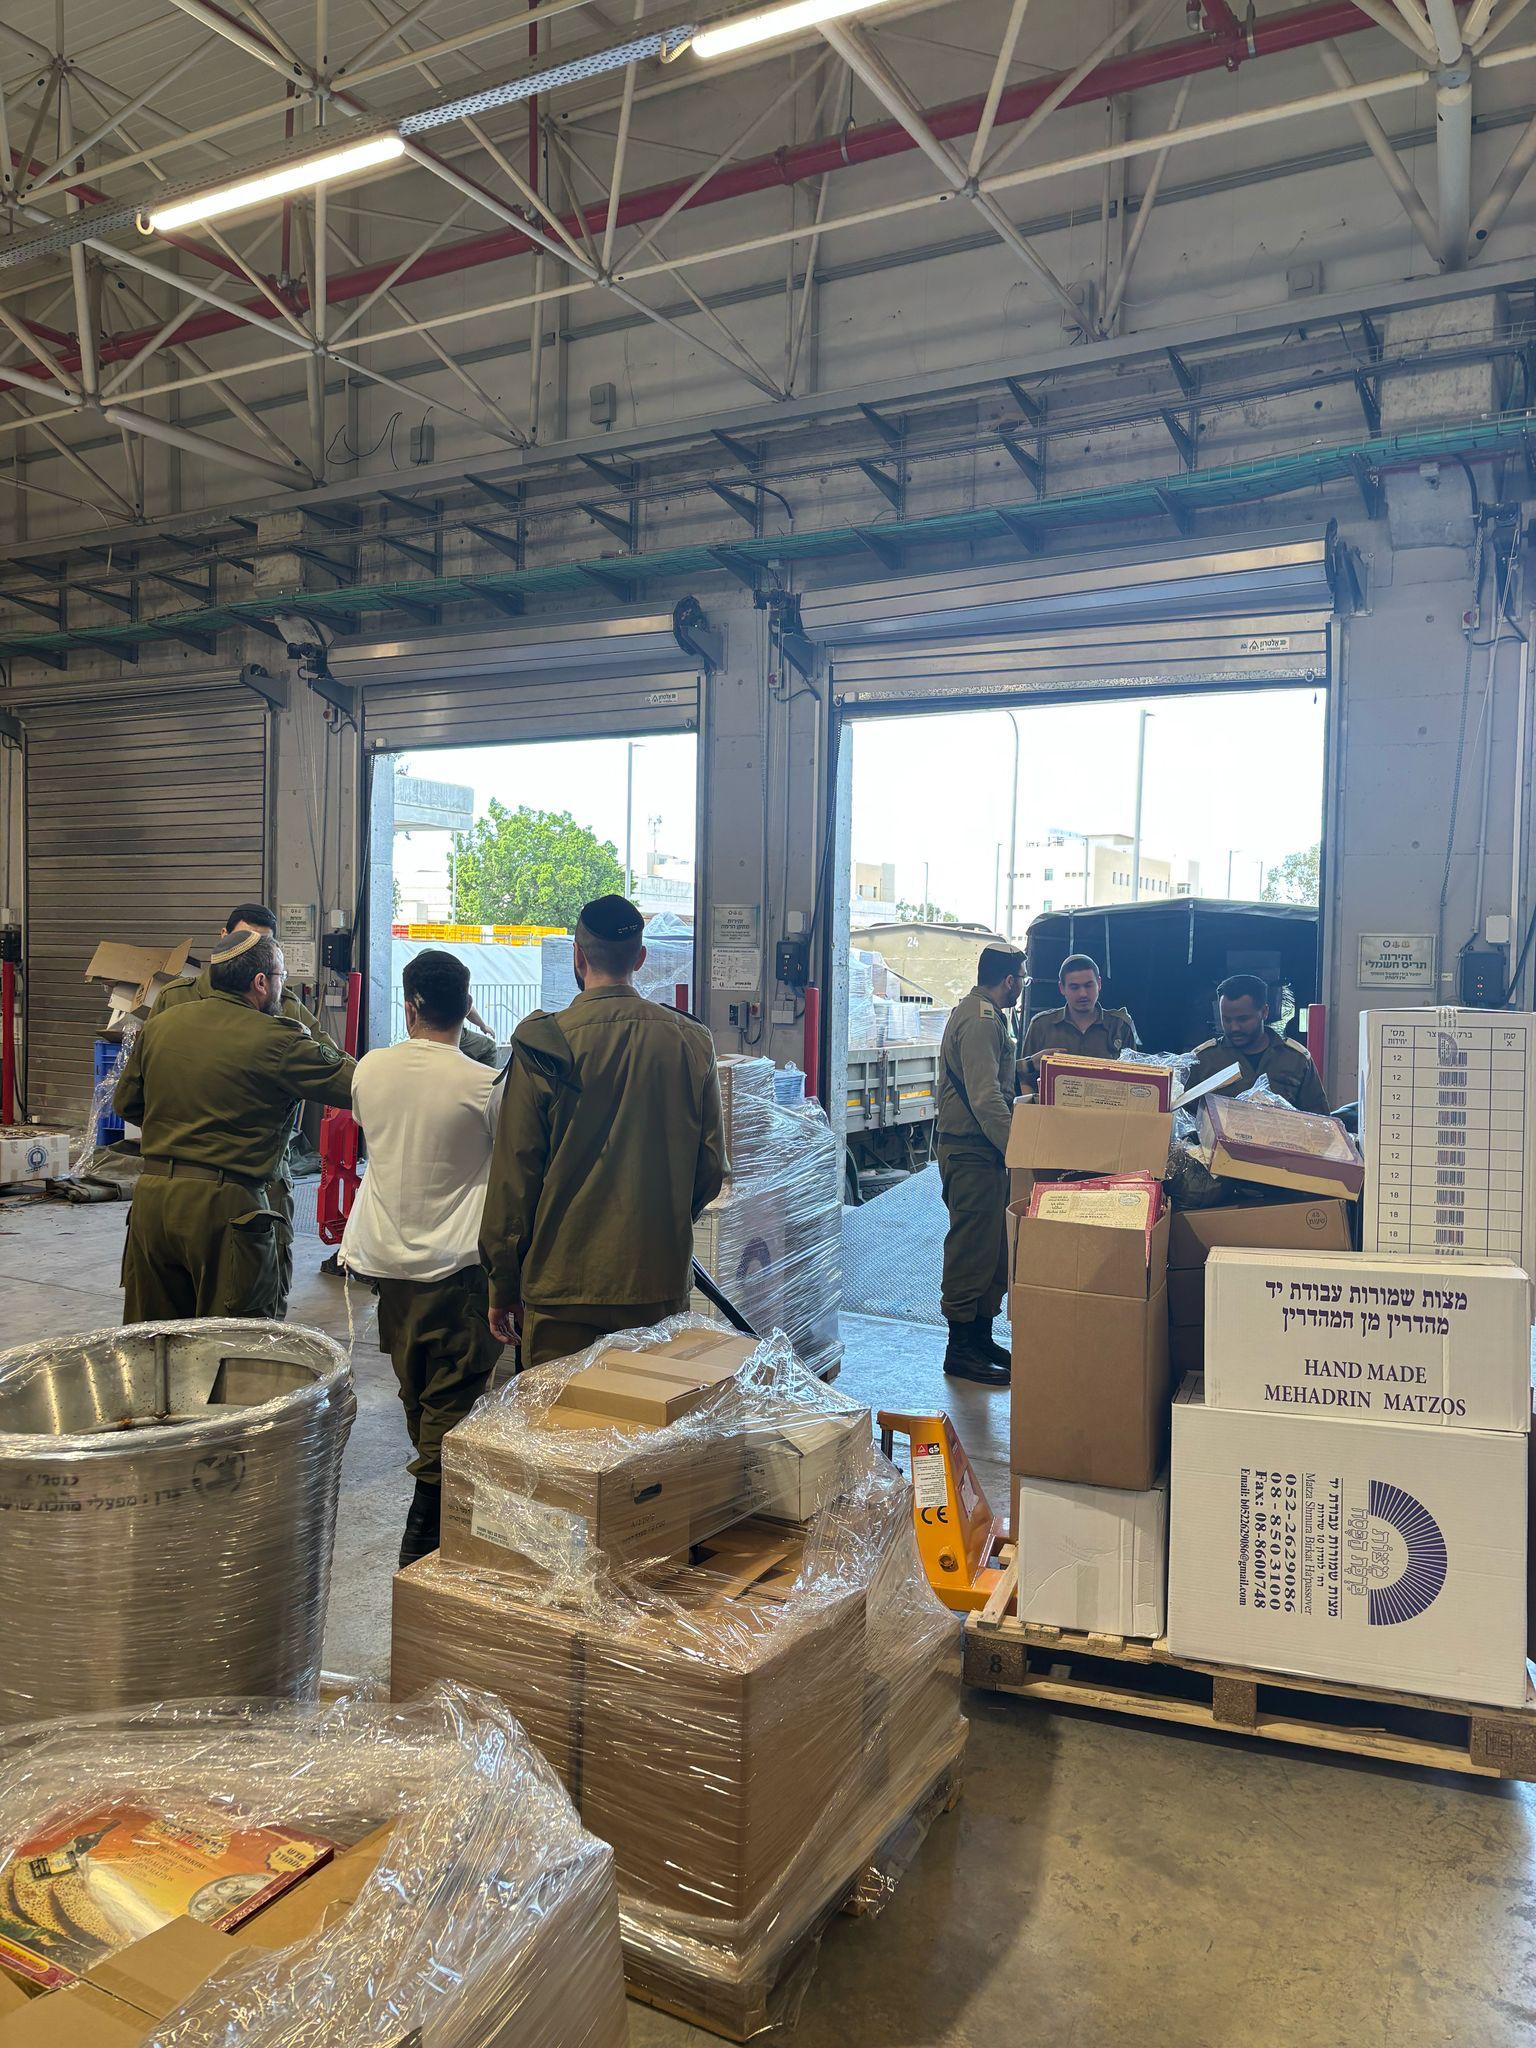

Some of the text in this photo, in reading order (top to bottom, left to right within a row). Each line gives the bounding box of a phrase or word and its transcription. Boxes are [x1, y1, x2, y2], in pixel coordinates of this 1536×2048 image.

[907, 936, 919, 948] 24
[1365, 959, 1427, 970] תריס חשמלי
[1379, 953, 1413, 962] זהירות
[1265, 1280, 1468, 1312] מצות שמורות עבודת יד
[1282, 1306, 1450, 1339] מהדרין מן המהדרין
[1304, 1358, 1428, 1384] HAND MADE
[1264, 1383, 1466, 1417] MEHADRIN MATZOS
[928, 1444, 941, 1455] GS
[920, 1505, 949, 1525] CE
[1316, 1503, 1325, 1531] שדרות
[1238, 1468, 1251, 1606] Email: b0522629086@gmail.com
[1254, 1470, 1268, 1609] Fax: 08-8600748
[1284, 1473, 1297, 1613] 052-2629086
[1303, 1472, 1315, 1615] Matza Shmura Birkat Ha'passover
[1316, 1534, 1325, 1544] 10
[1327, 1478, 1339, 1617] מצות שמורות עבודת יד
[1315, 1546, 1326, 1570] לונדון
